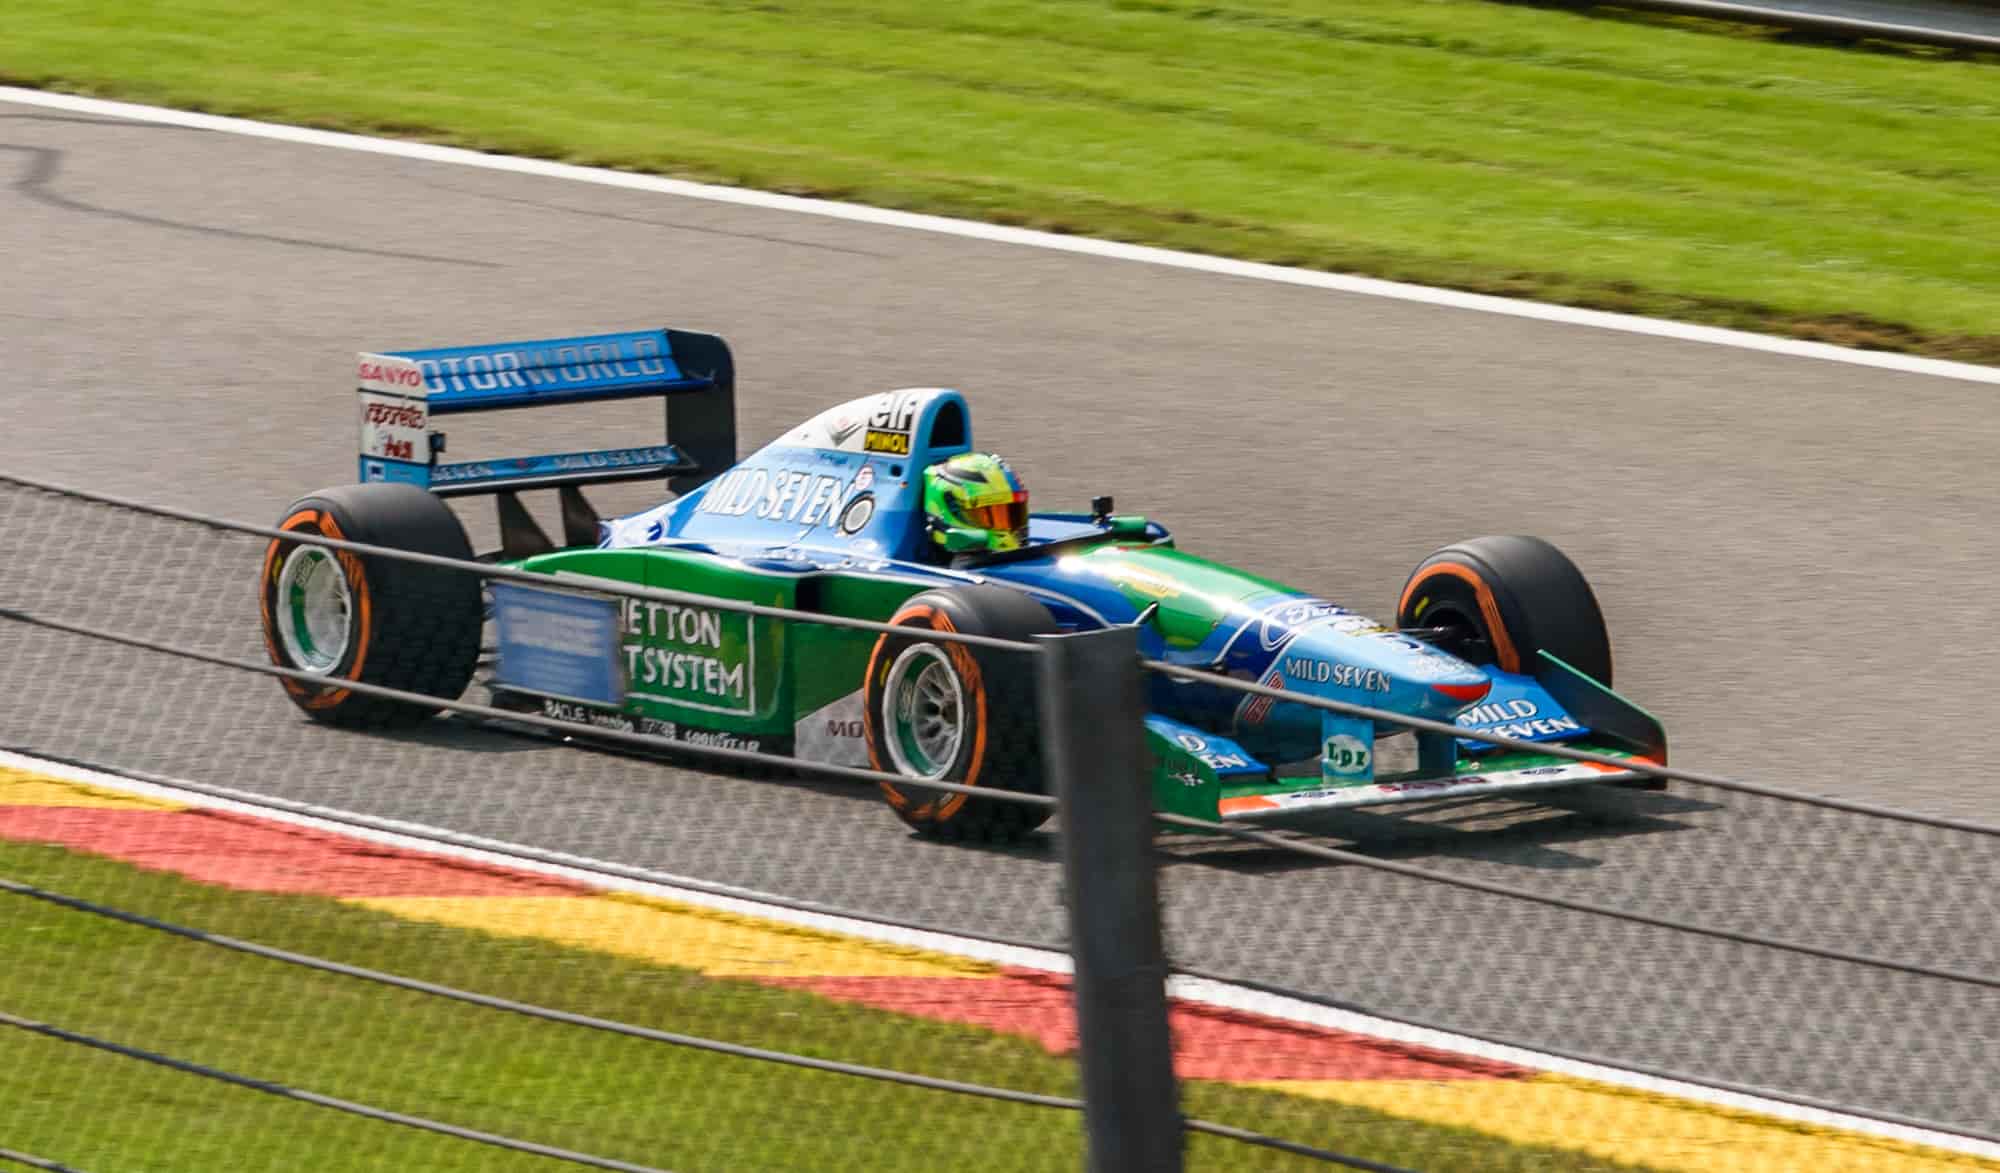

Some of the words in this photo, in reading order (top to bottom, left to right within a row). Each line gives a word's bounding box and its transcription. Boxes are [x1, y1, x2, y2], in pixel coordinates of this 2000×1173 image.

[359, 362, 422, 387] SANYO
[695, 467, 769, 517] MILD
[757, 468, 855, 528] SEVEN
[623, 644, 745, 699] TSYSTEM
[1284, 656, 1330, 683] MILD
[1333, 662, 1393, 693] SEVEN
[1457, 699, 1538, 726] MILD
